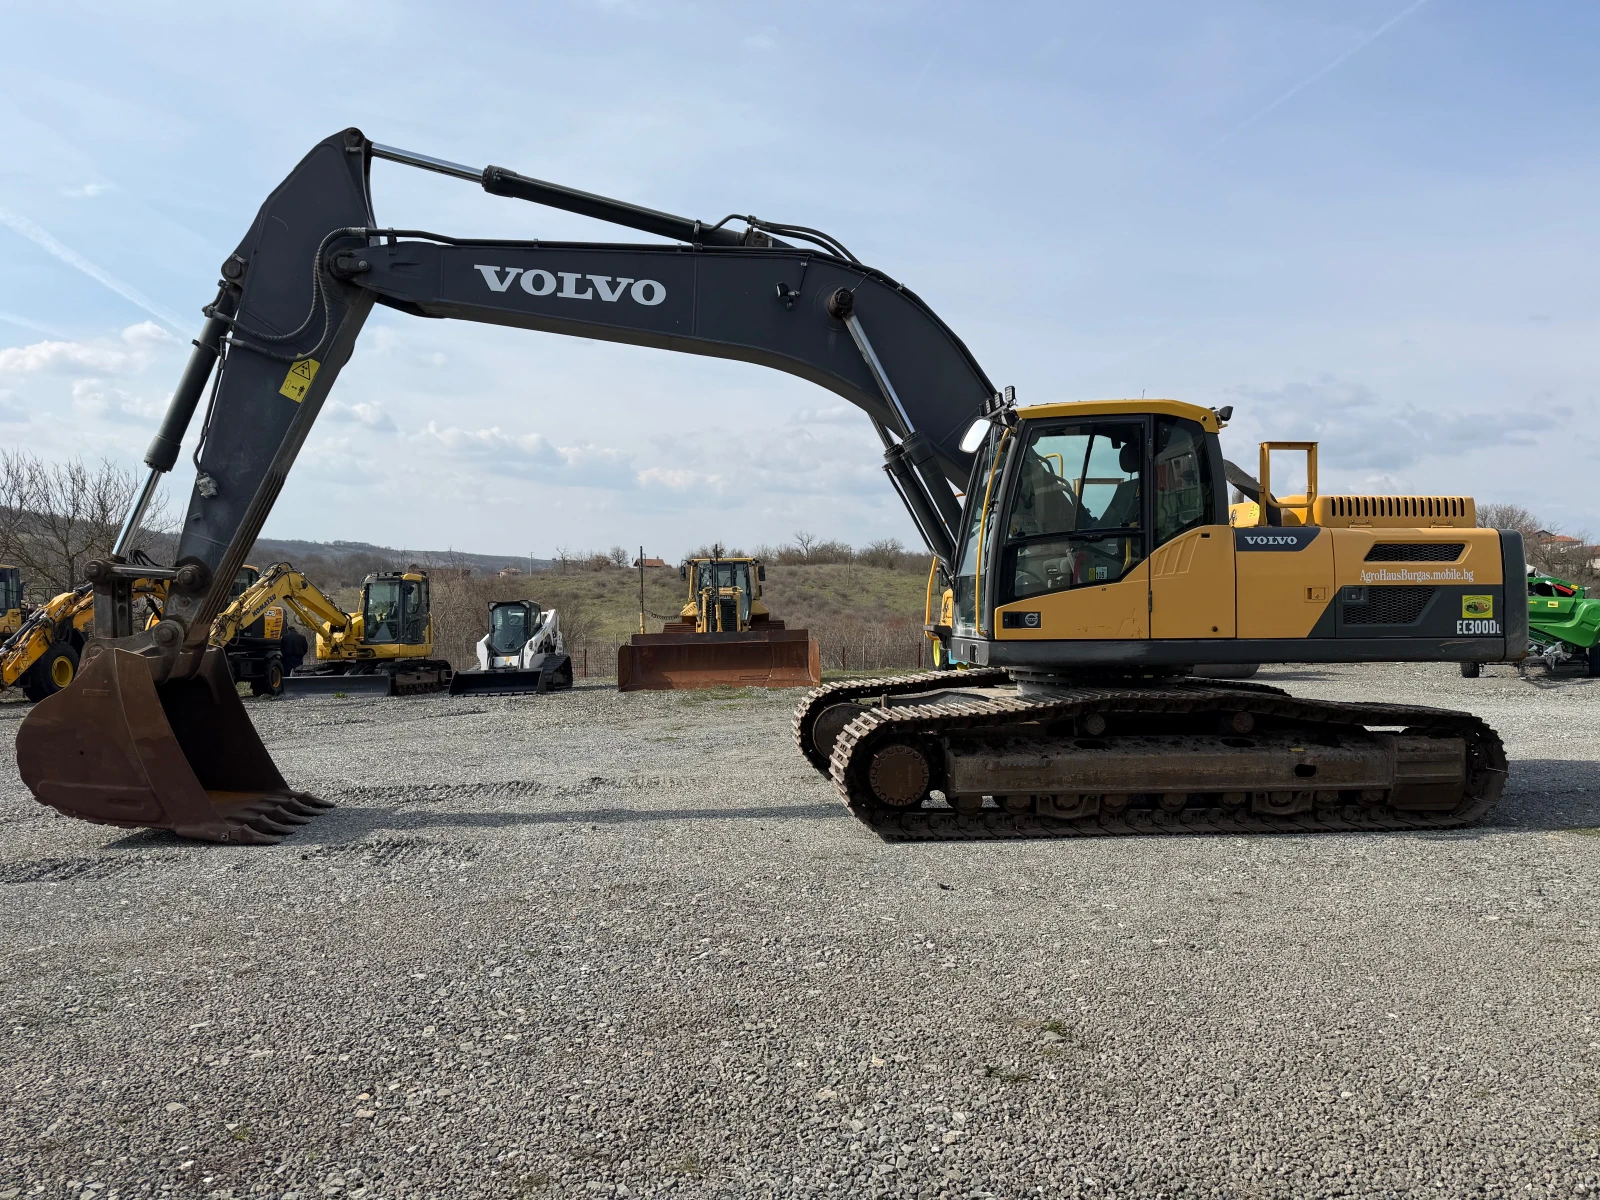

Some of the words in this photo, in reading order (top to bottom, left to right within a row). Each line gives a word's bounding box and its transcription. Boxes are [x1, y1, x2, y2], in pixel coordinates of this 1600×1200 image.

[474, 264, 667, 306] VOLVO
[1244, 536, 1298, 545] VOLVO
[1360, 568, 1474, 583] AgroHausBurgas.mobile.bg
[252, 593, 276, 618] KOMATSU
